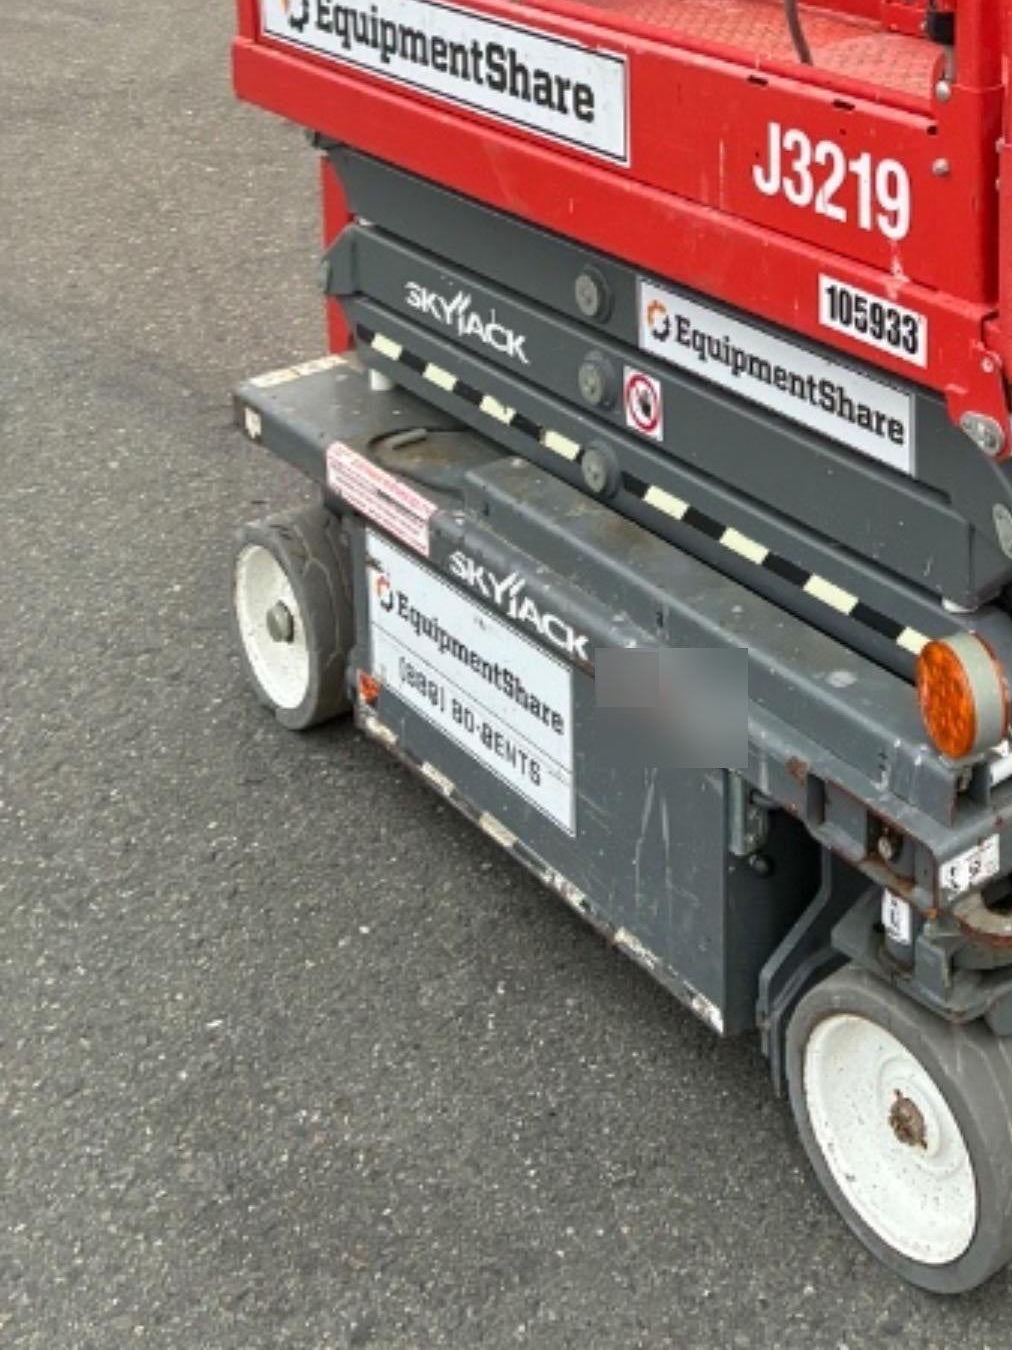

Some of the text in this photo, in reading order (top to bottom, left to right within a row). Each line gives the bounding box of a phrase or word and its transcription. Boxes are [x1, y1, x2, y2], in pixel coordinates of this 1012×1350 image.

[752, 122, 910, 241] J3219
[674, 314, 906, 446] EquipmentShare
[825, 284, 919, 355] 105933
[397, 592, 566, 737] EquipmentShare
